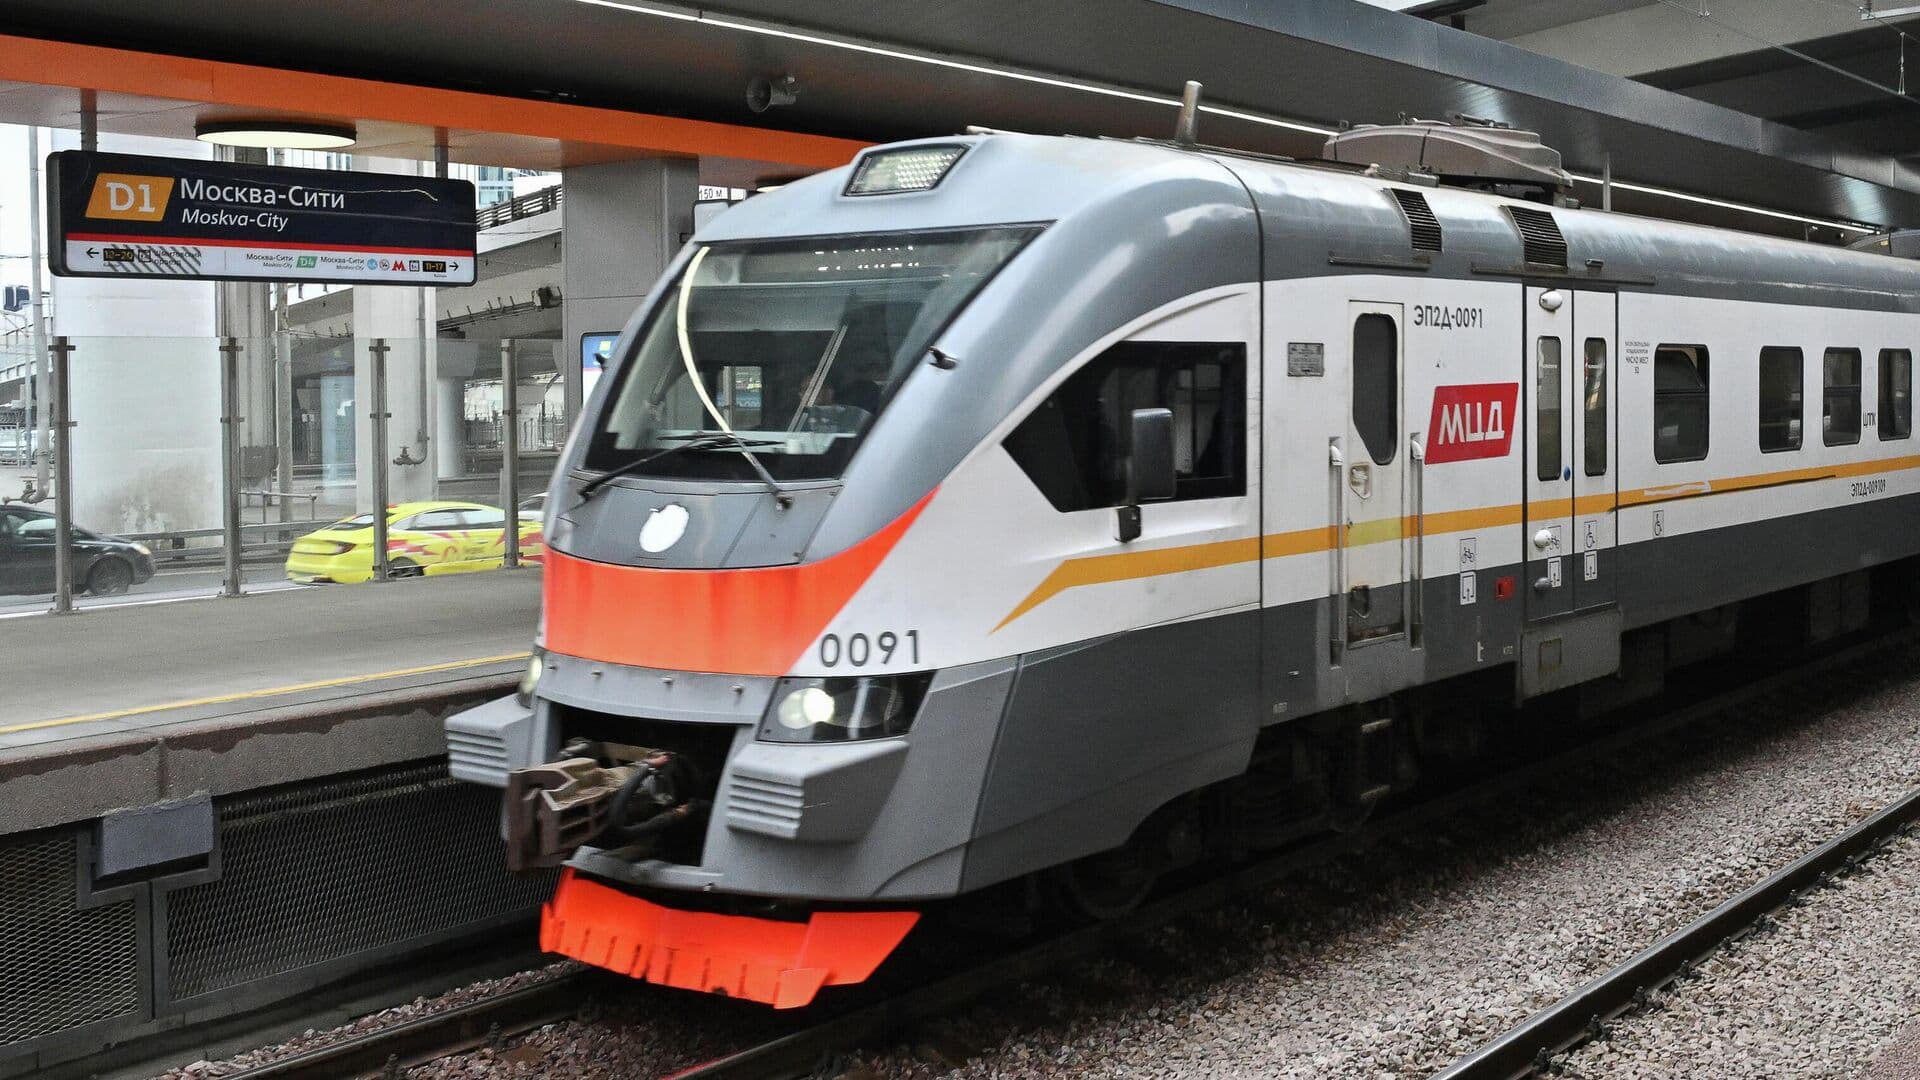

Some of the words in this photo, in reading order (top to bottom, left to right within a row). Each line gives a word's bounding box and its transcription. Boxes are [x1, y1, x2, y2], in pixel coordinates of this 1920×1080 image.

[106, 182, 155, 213] D1
[180, 178, 345, 209] Москва-Сити
[182, 208, 289, 232] Moskva-City
[246, 253, 293, 261] Москва-Сити
[320, 256, 364, 264] Москва-Сити
[1413, 305, 1484, 330] ЭП2Д-0091
[1438, 401, 1505, 446] МЦД
[820, 629, 920, 668] 0091
